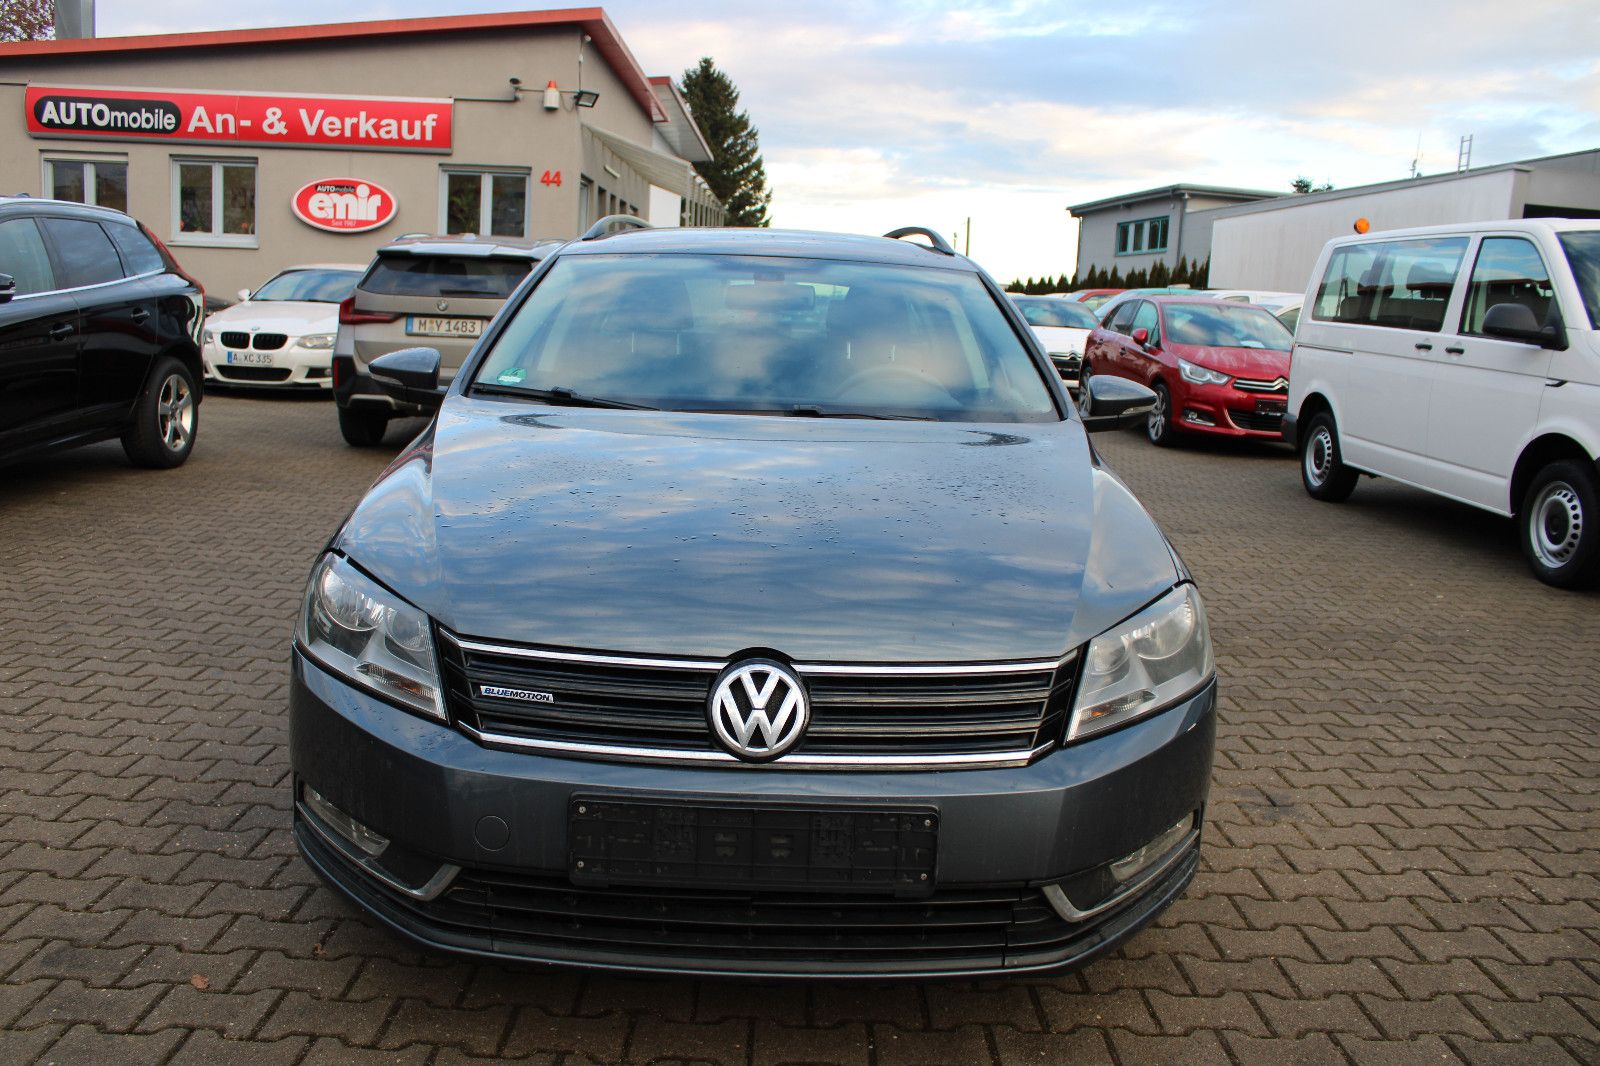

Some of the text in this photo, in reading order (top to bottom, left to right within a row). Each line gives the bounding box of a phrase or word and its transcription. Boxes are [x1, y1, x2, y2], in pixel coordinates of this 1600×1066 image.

[41, 101, 438, 141] AUTOmobile An- & Verkauf
[541, 170, 561, 187] 44
[316, 185, 355, 193] AUTOmobile
[308, 184, 382, 220] emir
[418, 319, 476, 333] M Y 1483
[484, 687, 550, 701] BLUEMOTION
